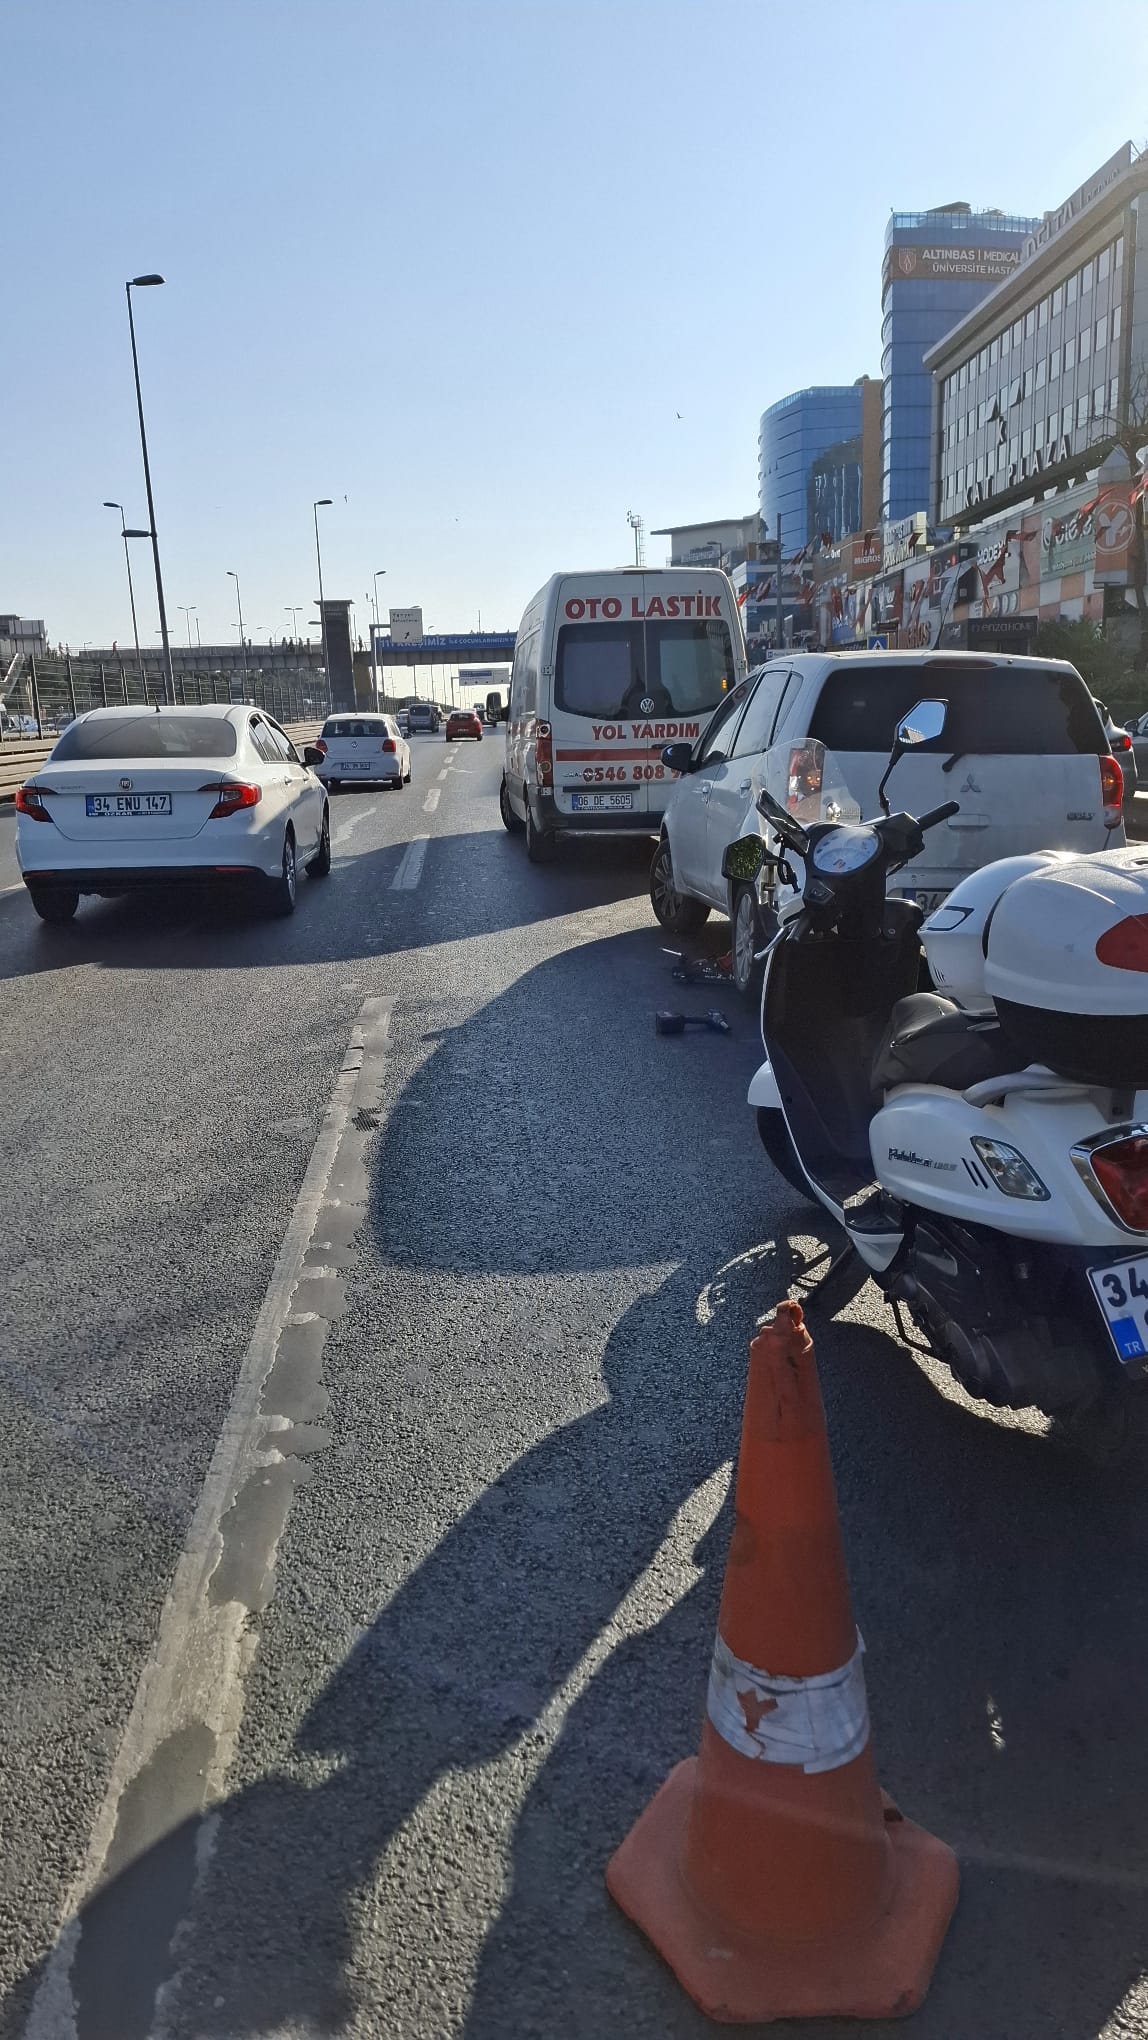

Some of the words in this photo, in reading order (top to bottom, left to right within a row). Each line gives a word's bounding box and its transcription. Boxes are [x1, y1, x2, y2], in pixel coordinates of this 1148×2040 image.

[1008, 434, 1070, 487] PLAZA
[565, 597, 623, 620] OTO
[631, 589, 722, 617] LASTİK
[592, 725, 627, 741] YOL
[632, 722, 700, 738] YARDIM
[583, 763, 626, 782] 0546
[632, 763, 665, 780] 808
[95, 797, 110, 811] 34
[117, 797, 140, 811] ENU
[146, 796, 167, 810] 147
[578, 796, 588, 806] 06
[594, 795, 604, 805] DE
[610, 794, 631, 805] 5605
[1102, 1267, 1148, 1308] 34
[1124, 1341, 1142, 1355] TR
